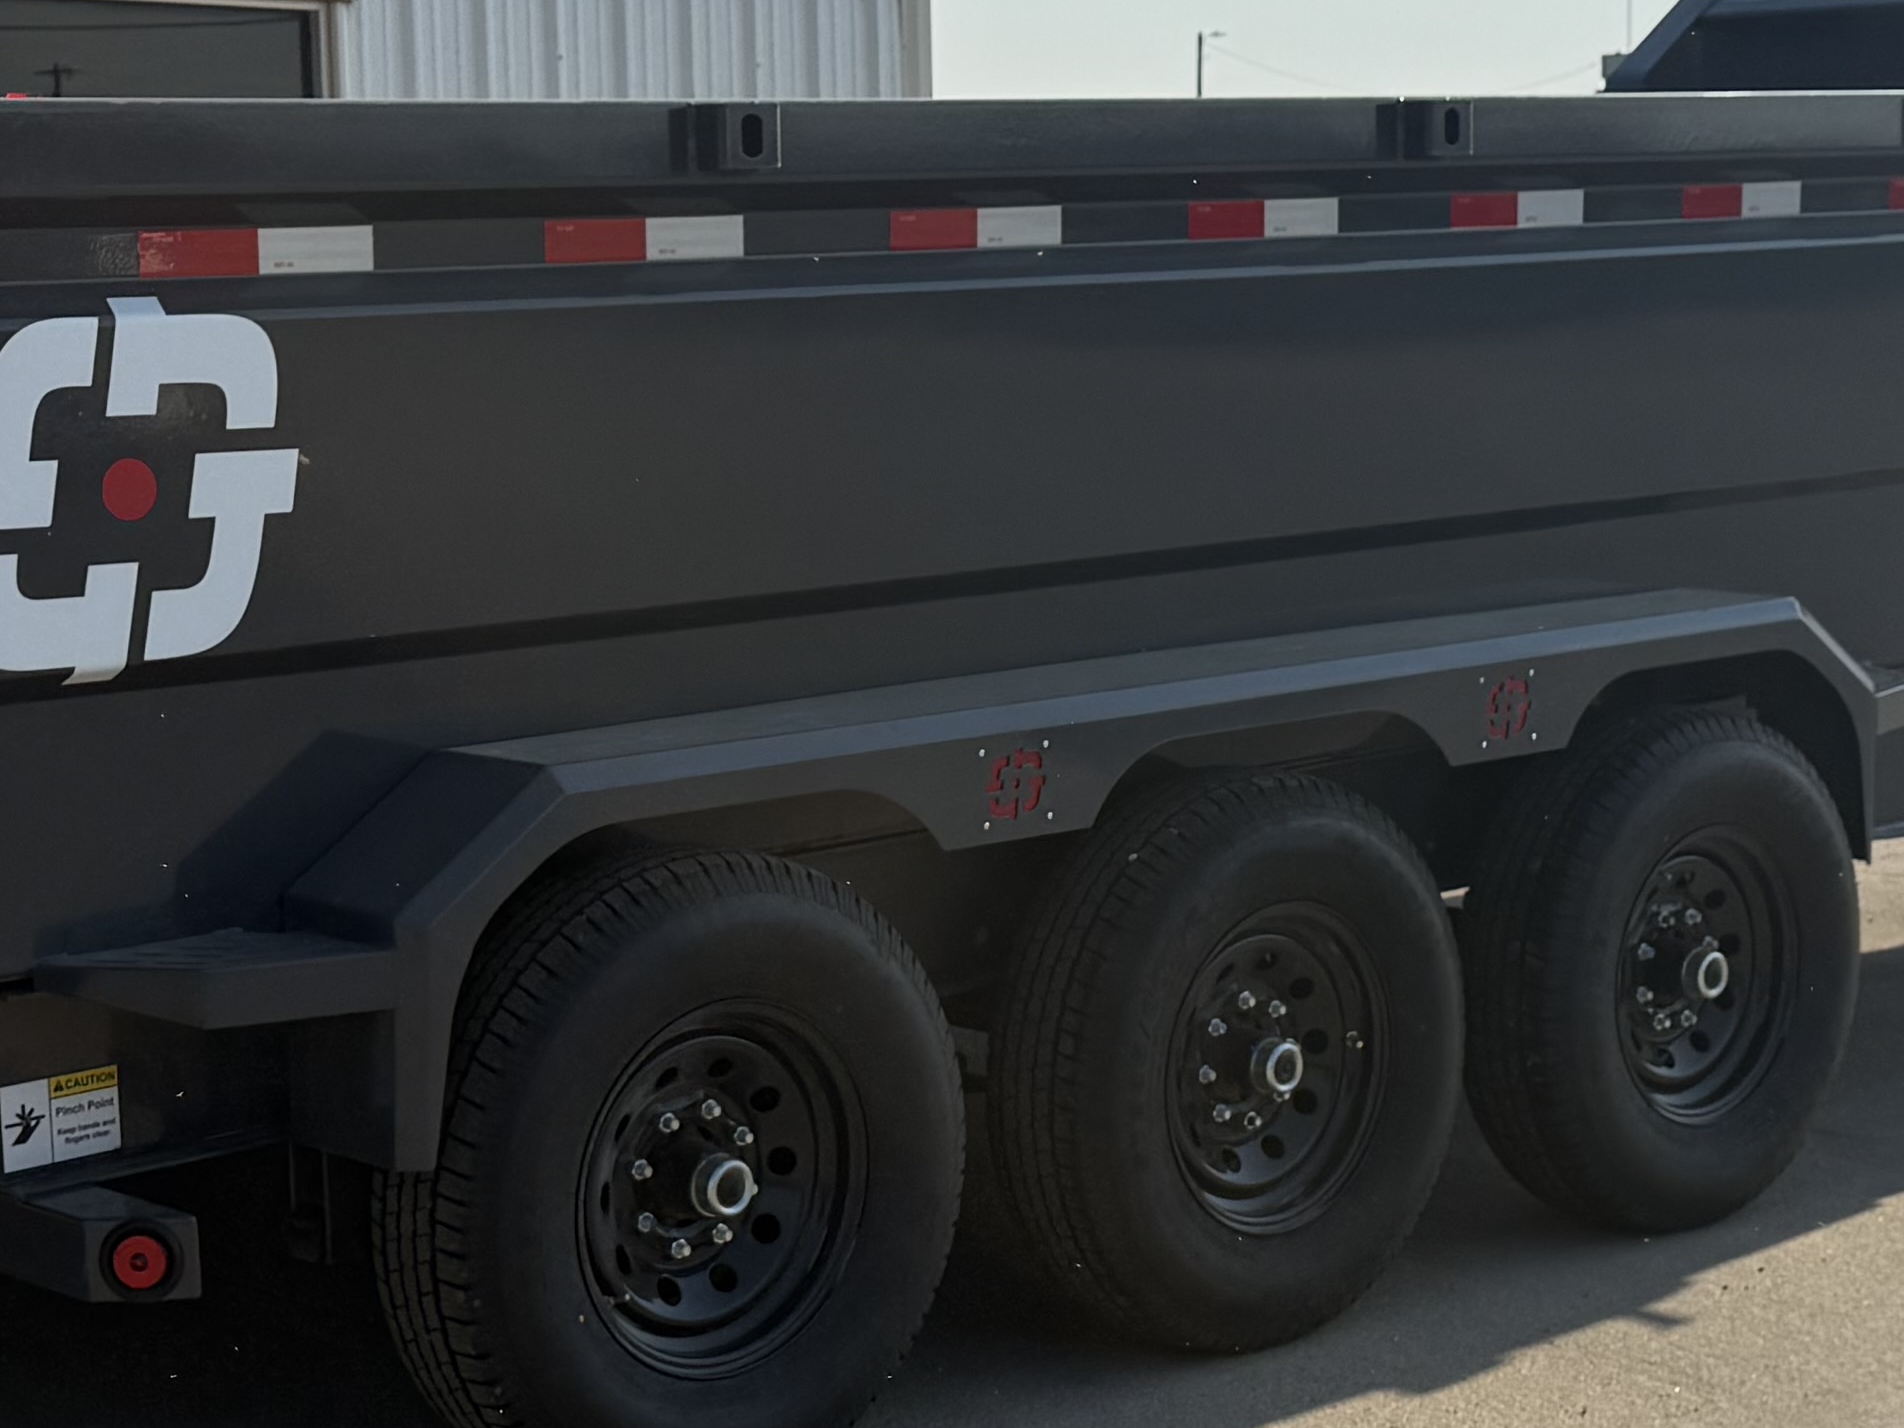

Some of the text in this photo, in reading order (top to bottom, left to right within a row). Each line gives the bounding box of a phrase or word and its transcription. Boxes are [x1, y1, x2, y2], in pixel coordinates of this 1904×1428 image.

[65, 1071, 116, 1090] CAUTION
[56, 1097, 115, 1117] Pinch Point
